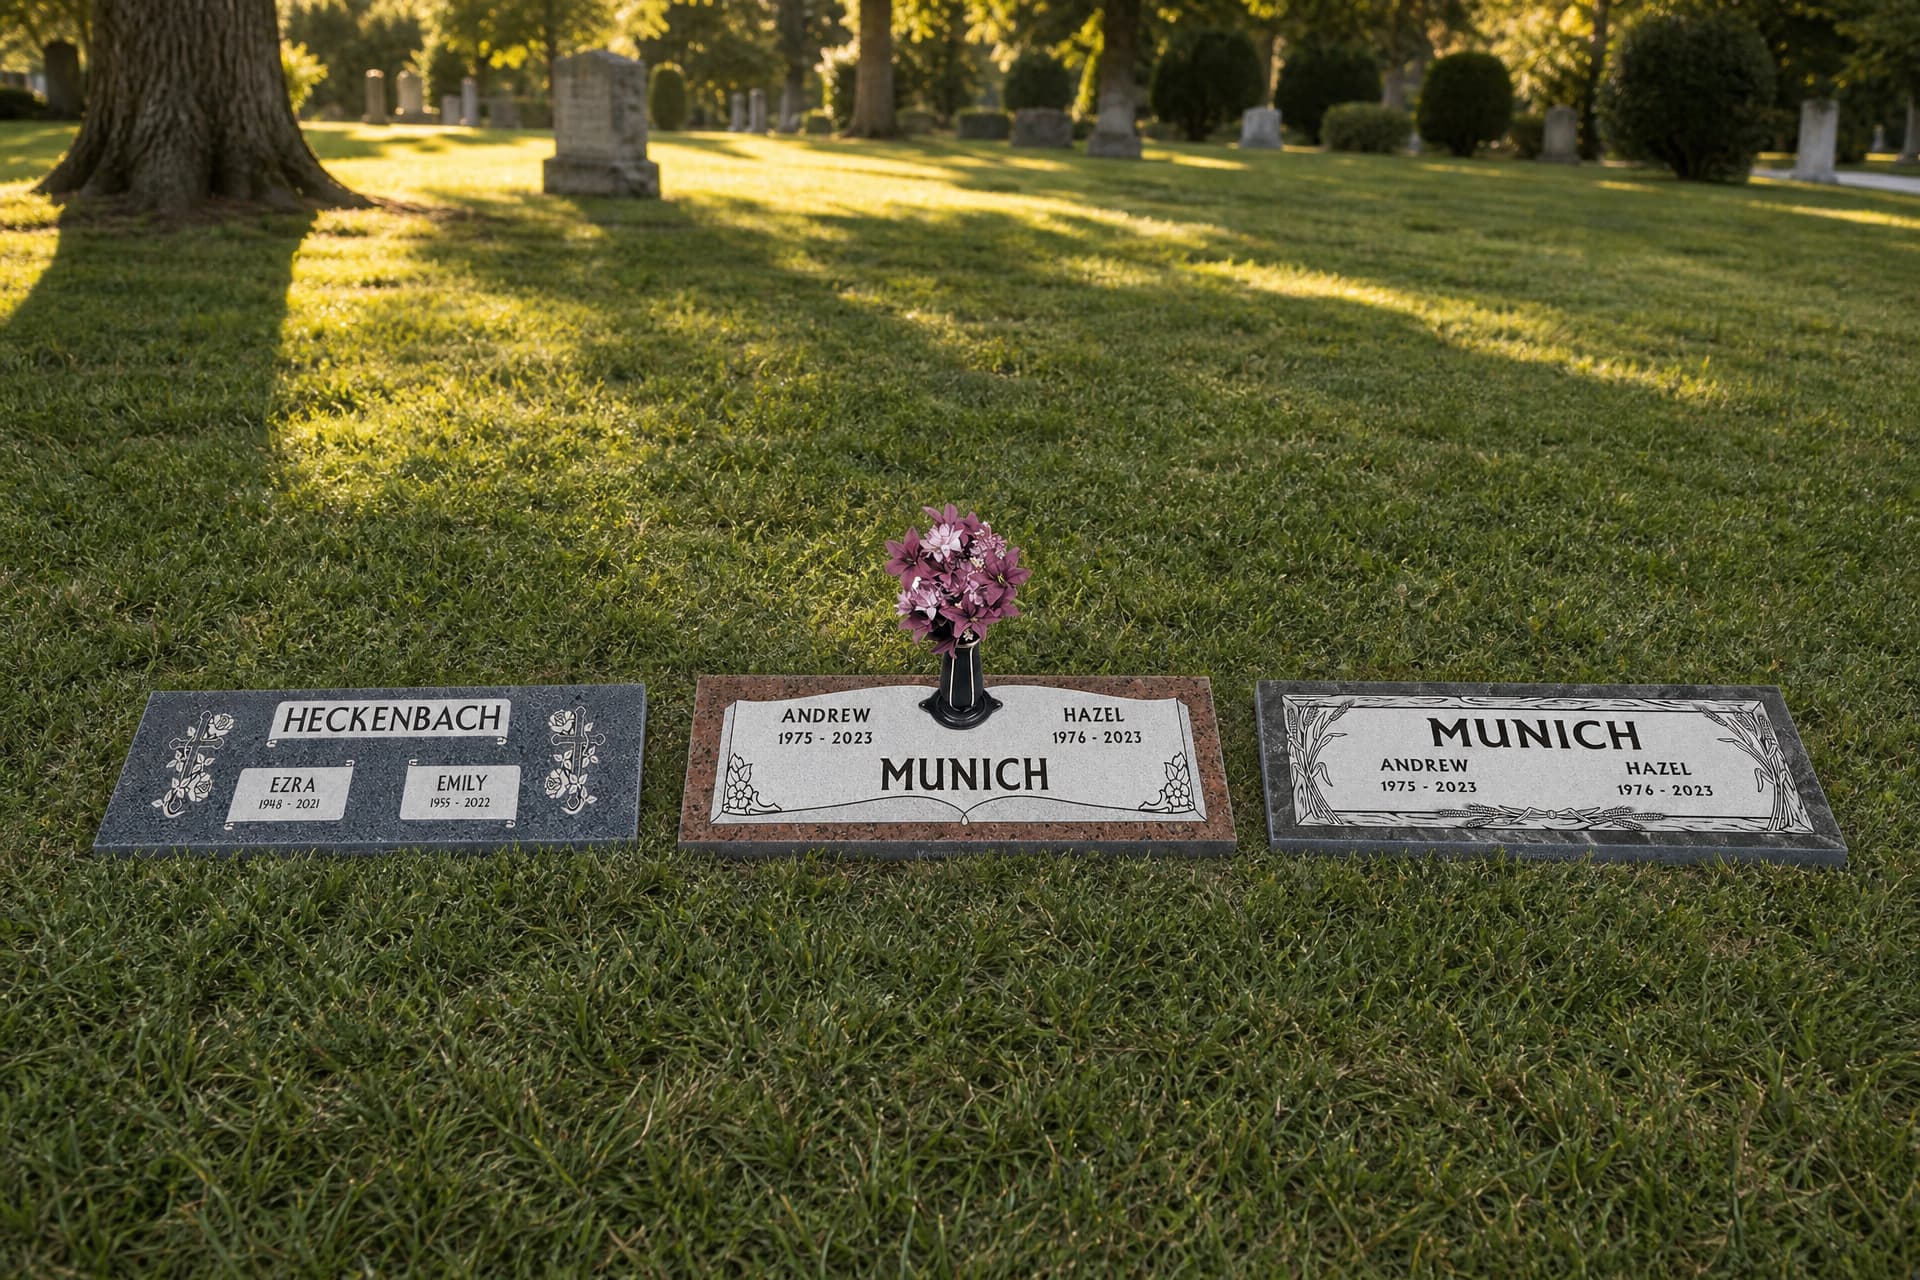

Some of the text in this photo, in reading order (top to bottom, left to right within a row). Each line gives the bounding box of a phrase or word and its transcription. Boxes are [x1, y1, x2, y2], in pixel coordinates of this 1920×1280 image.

[284, 705, 500, 732] HECKENBACH
[781, 707, 871, 723] ANDREW
[1063, 707, 1125, 723] HAZEL
[778, 731, 813, 745] 1975
[831, 731, 873, 745] 2023
[1052, 730, 1086, 744] 1976
[1103, 730, 1142, 744] 2023
[1427, 717, 1642, 750] MUNICH
[1380, 758, 1468, 773] ANDREW
[1625, 761, 1692, 776] HAZEL
[881, 758, 1048, 790] MUNICH
[269, 776, 316, 793] EZRA
[437, 774, 488, 791] EMILY
[1380, 780, 1416, 793] 1975
[1435, 781, 1477, 793] 2023
[1616, 783, 1654, 796] 1976
[1671, 784, 1714, 797] 2023
[258, 799, 283, 810] 1948
[295, 798, 320, 809] 2021
[430, 797, 451, 808] 1955
[464, 797, 490, 808] 2022
